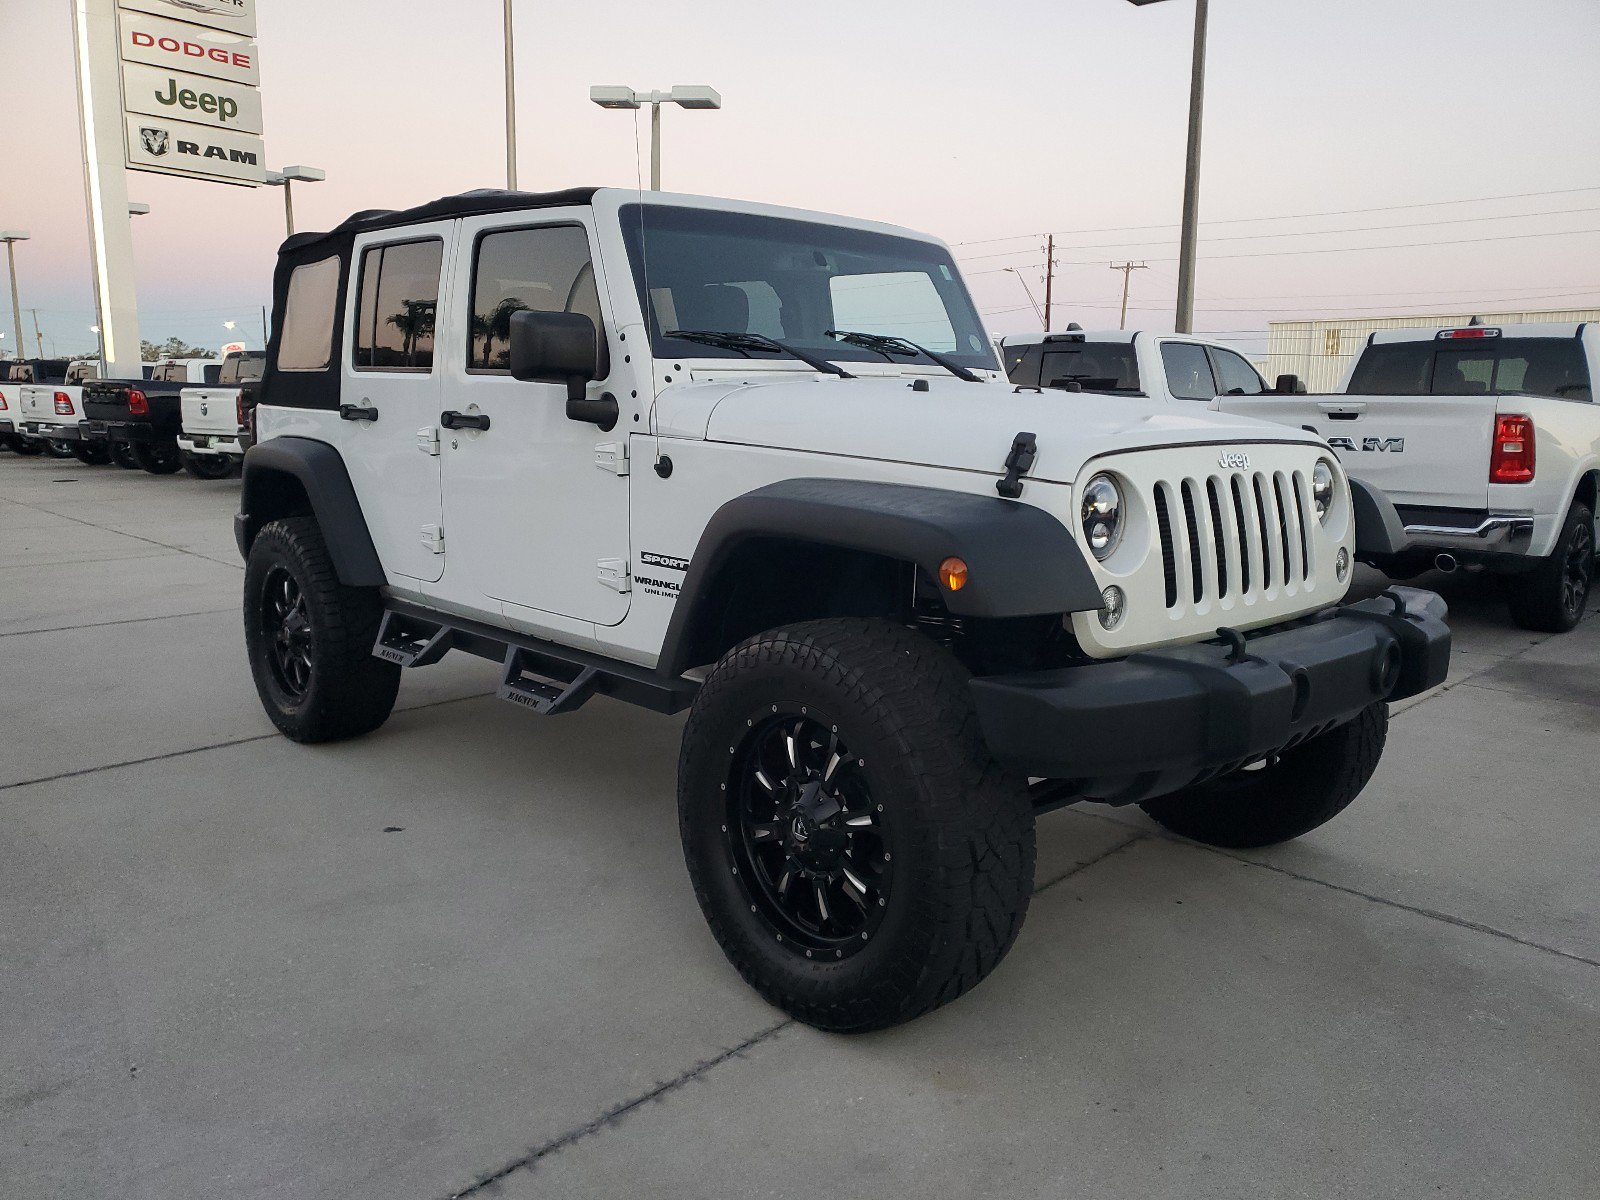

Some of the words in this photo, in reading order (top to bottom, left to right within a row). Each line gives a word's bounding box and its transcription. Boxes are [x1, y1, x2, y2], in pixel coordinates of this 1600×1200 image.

[131, 31, 251, 69] DODGE
[155, 78, 238, 122] Jeep
[176, 140, 258, 166] RAM
[1326, 436, 1405, 453] AM
[1218, 449, 1251, 471] Jeep
[642, 553, 687, 569] SPORT
[634, 575, 682, 592] WRANGL
[644, 587, 681, 599] UNLIMIT
